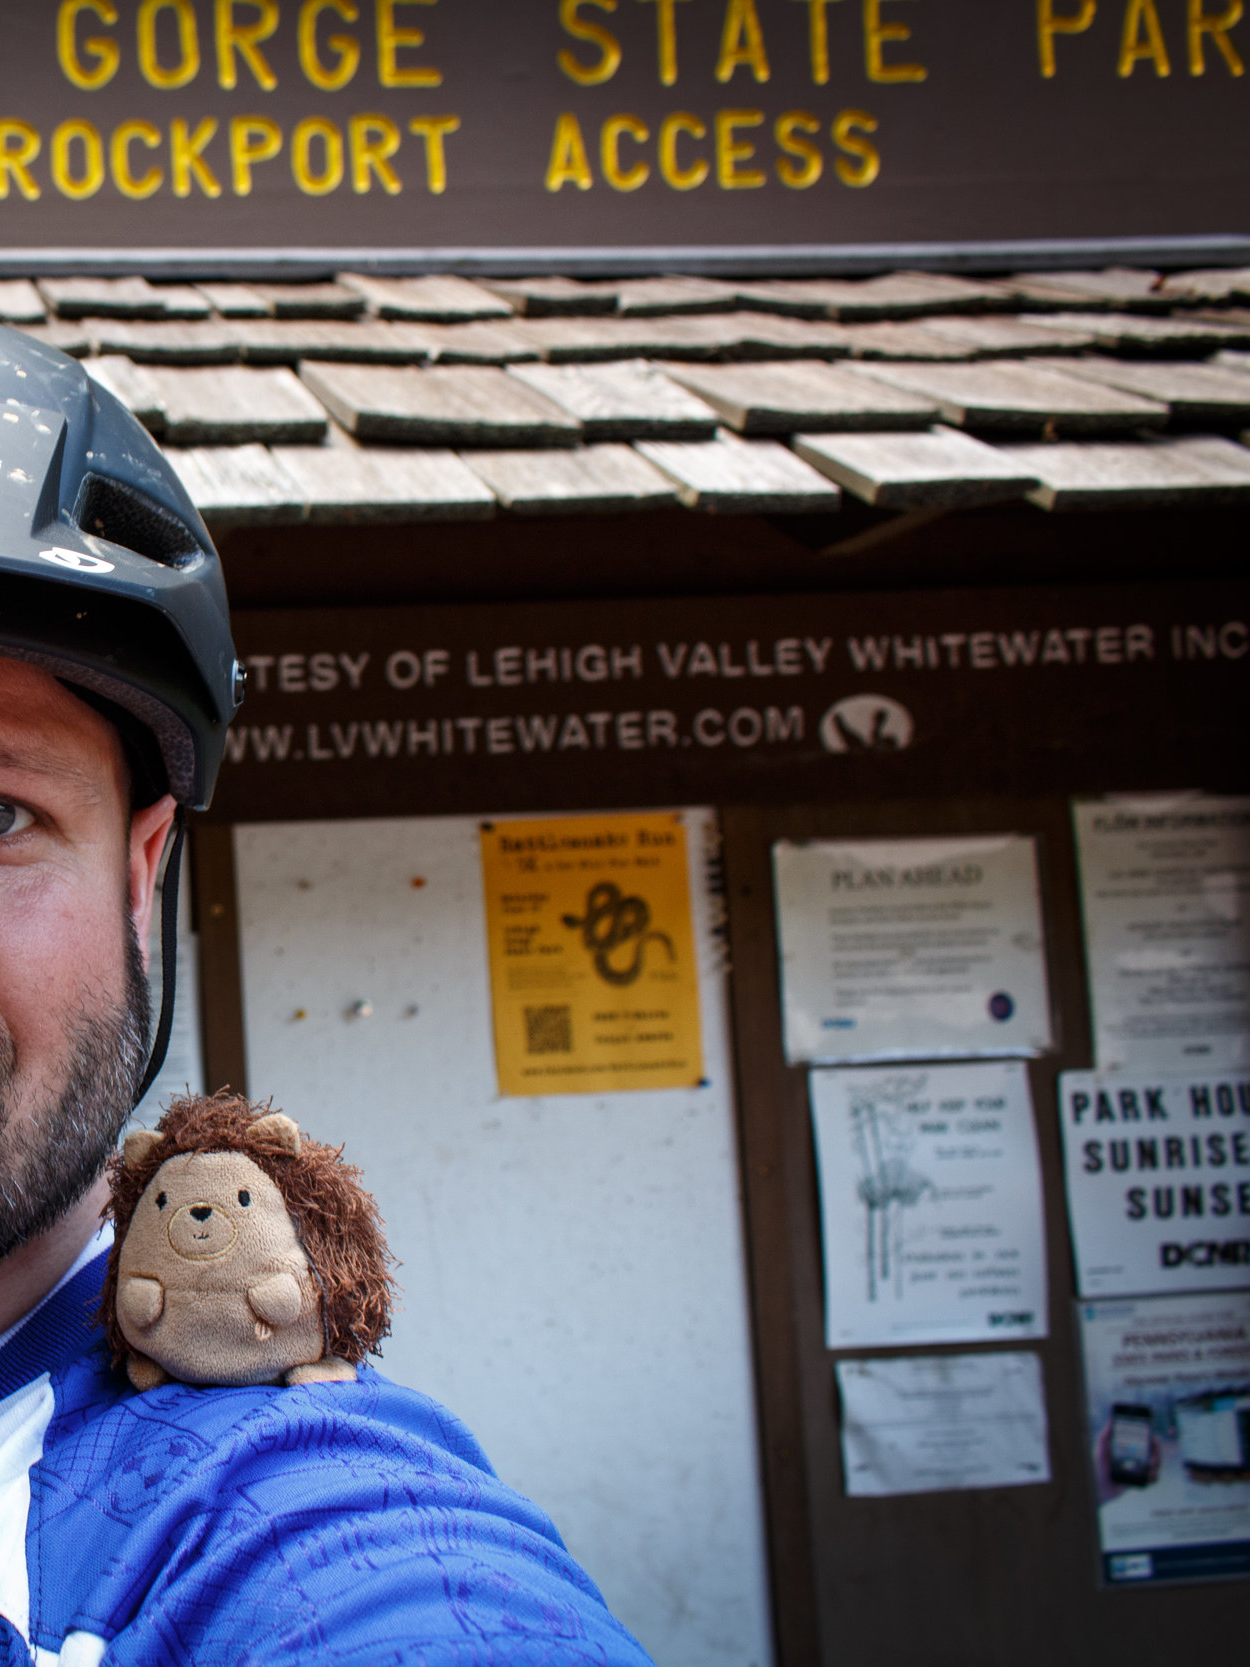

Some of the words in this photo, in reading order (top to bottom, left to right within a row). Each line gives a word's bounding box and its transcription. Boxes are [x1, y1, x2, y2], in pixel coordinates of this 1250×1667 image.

[56, 0, 443, 91] GORGE
[557, 0, 927, 86] STATE
[544, 108, 881, 192] ACCESS
[387, 650, 450, 689] OF
[468, 642, 642, 687] LEHIGH
[658, 637, 831, 677] VALLEY
[848, 623, 1155, 669] WHITEWATER
[1170, 620, 1249, 661] INC
[1071, 1089, 1168, 1124] PARK
[1083, 1131, 1249, 1175] SUNRISE
